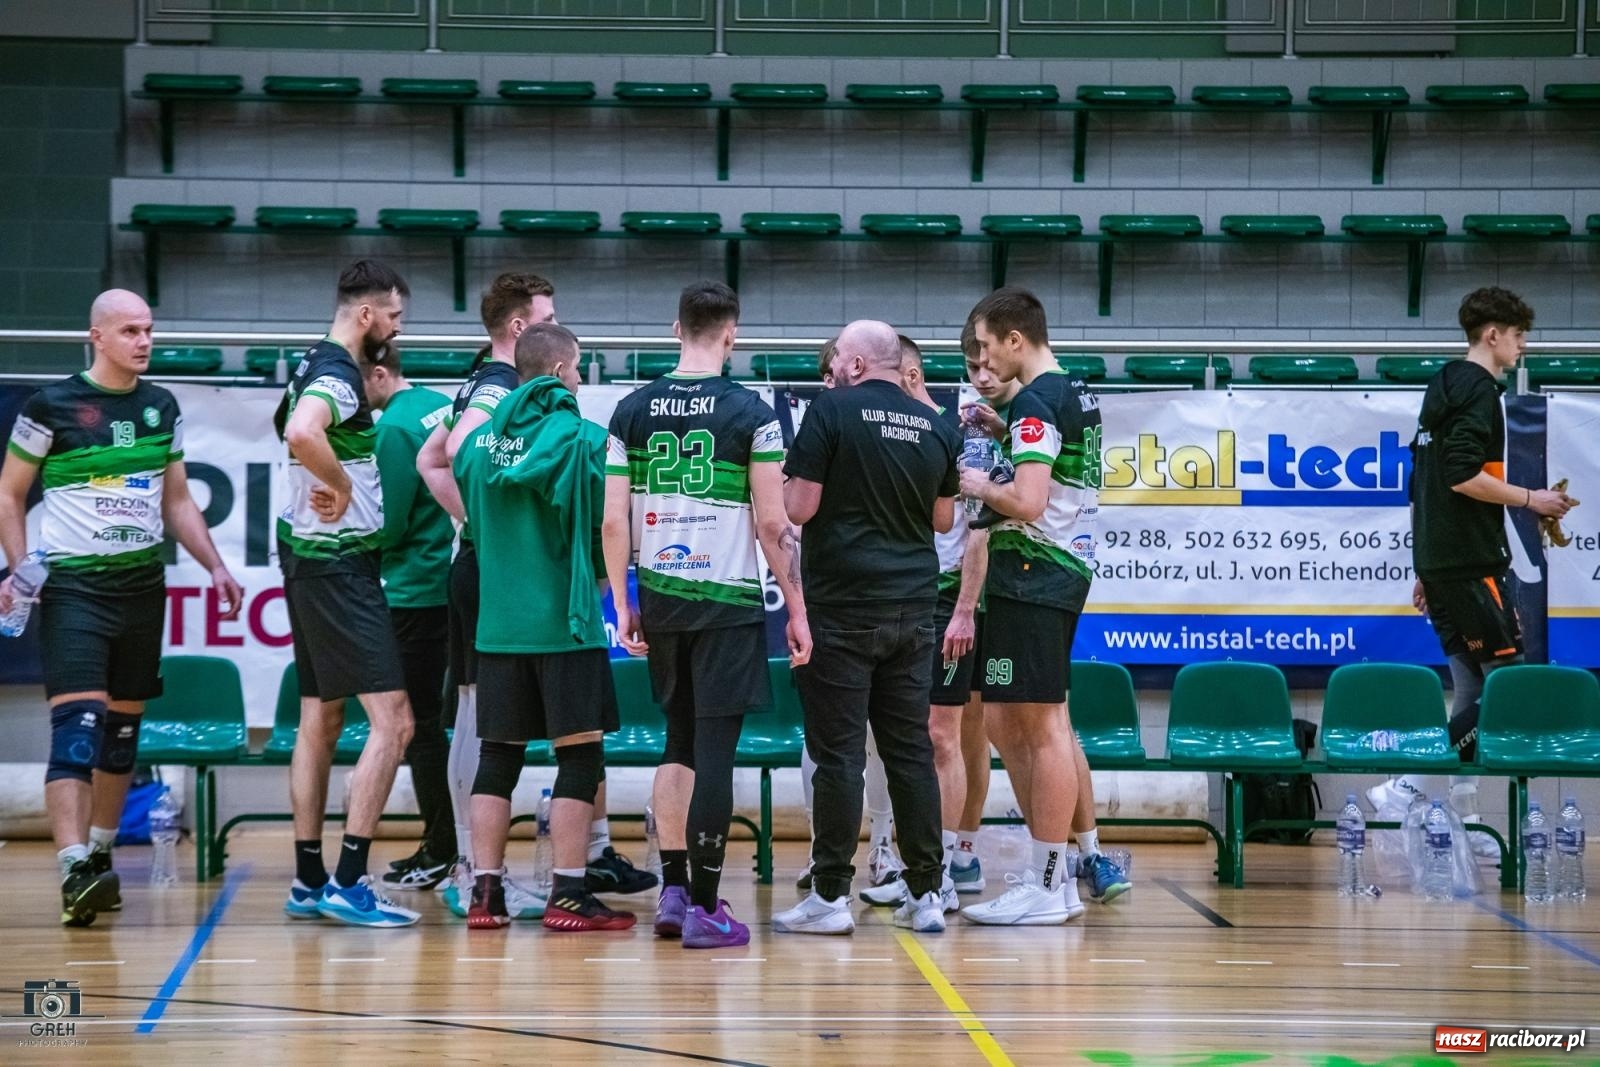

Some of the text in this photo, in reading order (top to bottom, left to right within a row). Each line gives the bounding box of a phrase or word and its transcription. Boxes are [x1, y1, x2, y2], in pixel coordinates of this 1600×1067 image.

[650, 396, 715, 416] SKULSKI
[862, 409, 932, 431] KLUB SIATKARSKI
[110, 420, 136, 447] 19
[881, 425, 920, 443] RACIBÓRZ
[646, 429, 714, 494] 23
[1105, 530, 1131, 549] 92
[1139, 529, 1172, 550] 88,
[1184, 531, 1225, 549] 502
[1232, 530, 1272, 550] 632
[1280, 530, 1327, 551] 695,
[1339, 530, 1381, 549] 606
[652, 561, 711, 570] UBEZPIECZENIA
[1196, 560, 1222, 580] ul.
[1229, 560, 1244, 580] J.
[1251, 566, 1291, 580] von
[1299, 561, 1417, 580] Eichendor
[1104, 626, 1356, 656] www.instal-tech.pl
[943, 660, 958, 686] 7
[985, 658, 1013, 685] 99
